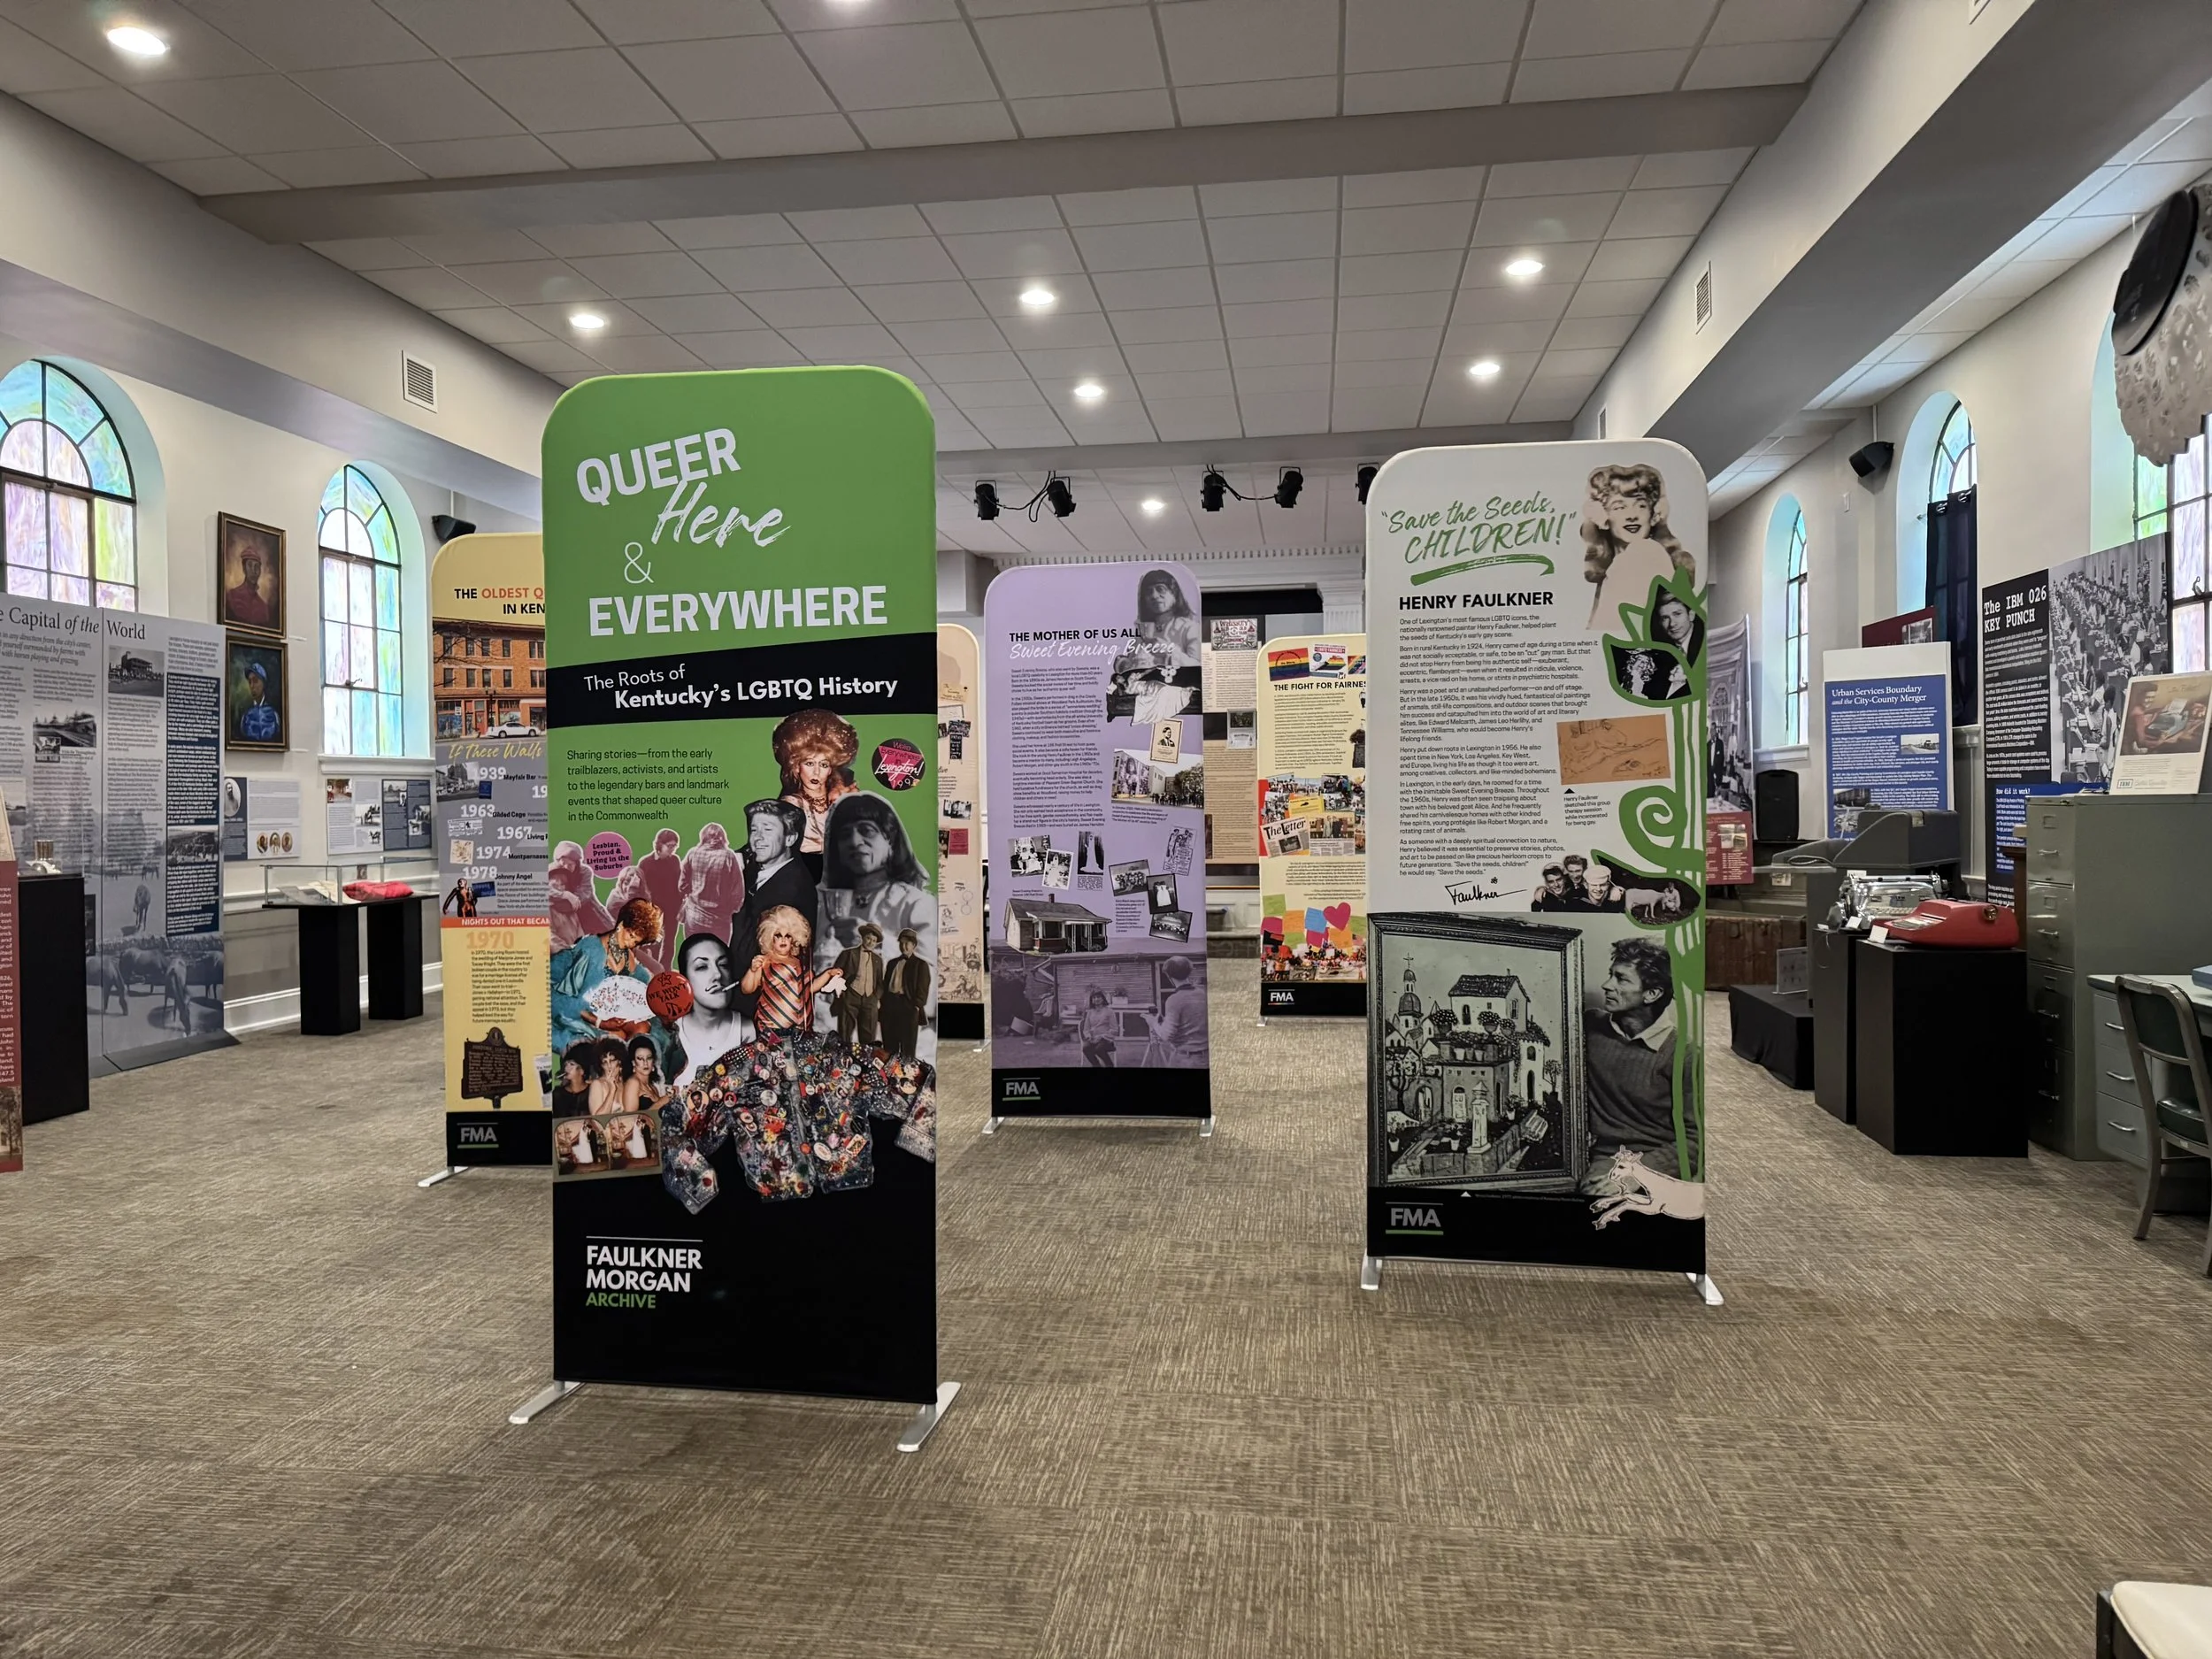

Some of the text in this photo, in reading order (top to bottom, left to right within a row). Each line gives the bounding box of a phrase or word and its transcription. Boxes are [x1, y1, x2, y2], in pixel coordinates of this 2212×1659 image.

[576, 427, 741, 506] QUEER
[651, 480, 791, 548] Here
[1447, 500, 1480, 525] the
[1485, 490, 1555, 519] Seeds,
[623, 541, 654, 584] &
[454, 588, 478, 599] THE
[481, 588, 529, 599] OLDEST
[1399, 591, 1554, 611] HENRY FAULKNER
[1984, 585, 2047, 615] The IBM 026
[503, 603, 517, 615] IN
[588, 585, 888, 637] EVERYWHERE
[9, 607, 60, 631] Capital
[65, 616, 80, 635] of
[81, 618, 99, 634] the
[107, 620, 146, 640] World
[1985, 608, 2036, 633] KEY PUNCH
[1010, 628, 1141, 642] THE MOTHER OF US ALL
[1010, 638, 1177, 665] Sweet Evening Breeze
[584, 664, 686, 693] The Roots of
[615, 675, 898, 709] Kentucky's LGBTQ History
[1886, 685, 1922, 695] Boundary
[1854, 695, 1899, 706] City-County
[1900, 695, 1927, 704] Merger
[465, 743, 501, 759] These
[503, 742, 544, 760] Walls
[567, 750, 603, 762] Sharing
[672, 749, 688, 758] the
[690, 749, 713, 760] early
[474, 766, 506, 780] 939
[567, 764, 718, 775] trailblazers, activists, and artists
[874, 754, 925, 781] Lexington!
[567, 780, 730, 792] to the legendary bars and landmark
[568, 795, 722, 806] events that shaped queer culture
[461, 803, 495, 818] 1963
[568, 810, 669, 821] in the Commonwealth
[497, 826, 533, 841] 1967
[1263, 820, 1306, 840] The Letter
[476, 846, 511, 859] 1974
[462, 865, 497, 879] 1978
[466, 932, 514, 949] 1970
[649, 991, 660, 1000] WE
[661, 990, 680, 1002] TALK
[1270, 992, 1294, 1002] FMA
[1006, 1081, 1040, 1095] FMA
[461, 1126, 497, 1142] FMA
[1391, 1207, 1441, 1227] FMA
[587, 1245, 703, 1269] FAULKNER
[586, 1269, 690, 1293] MORGAN
[586, 1292, 656, 1309] ARCHIVE
